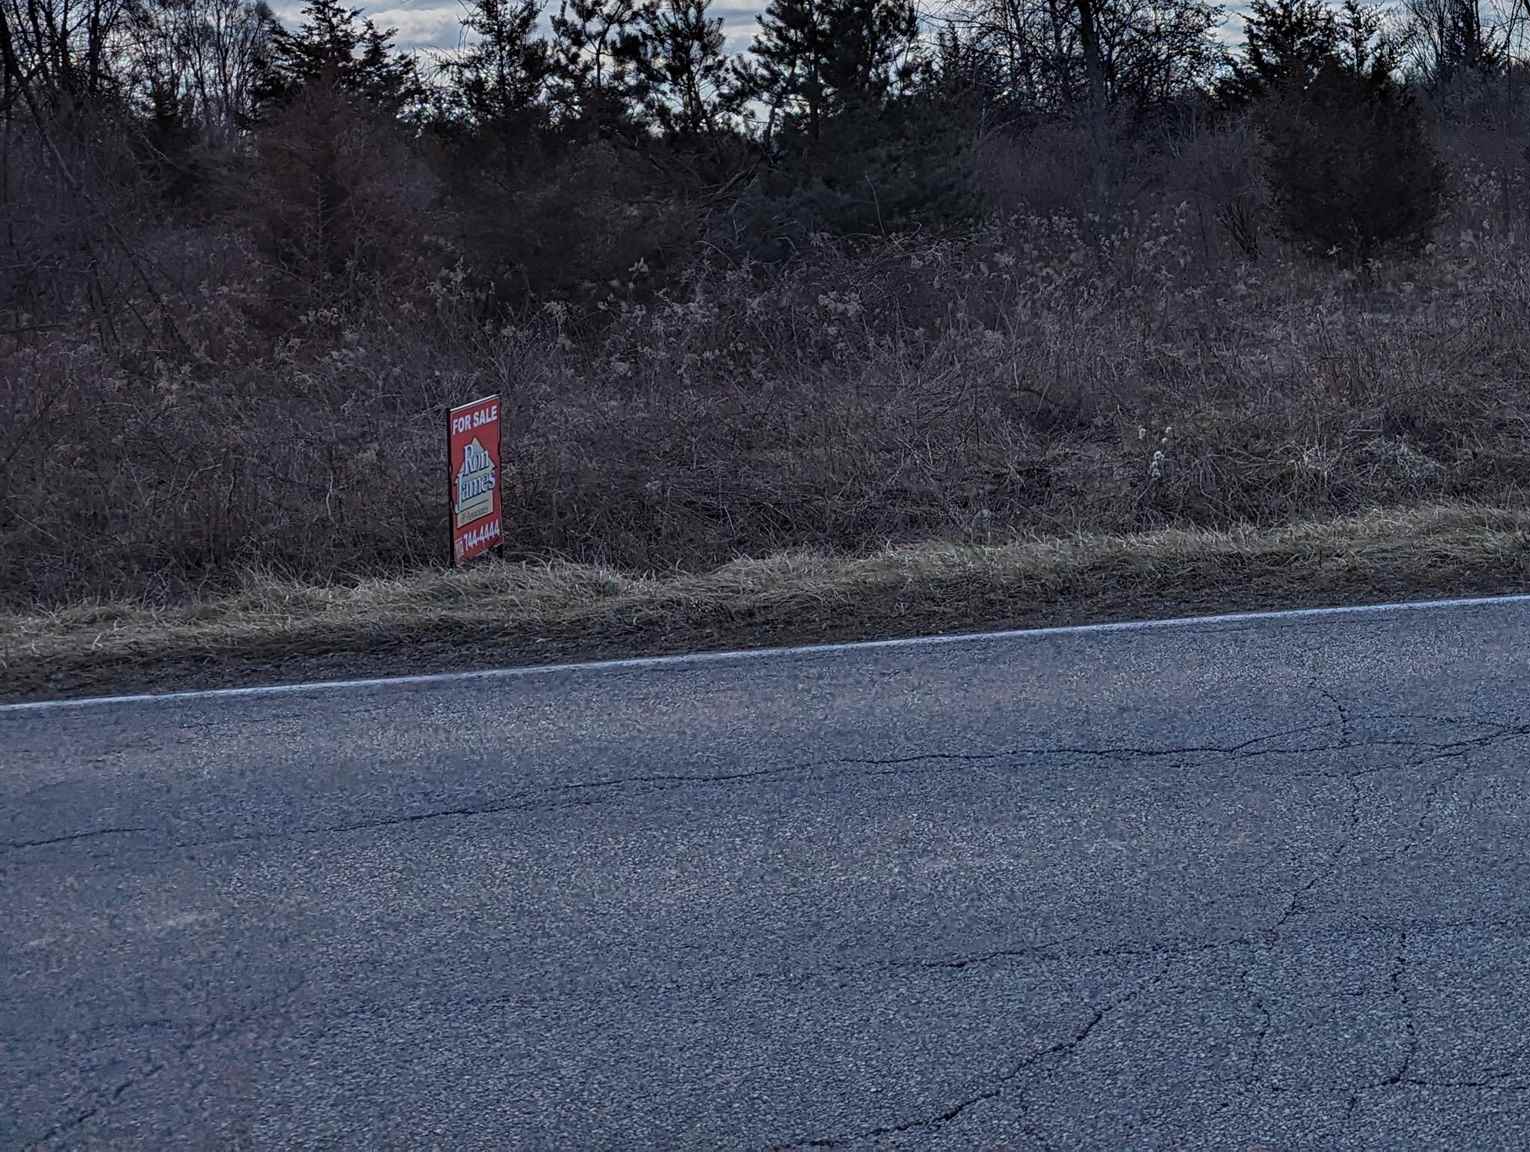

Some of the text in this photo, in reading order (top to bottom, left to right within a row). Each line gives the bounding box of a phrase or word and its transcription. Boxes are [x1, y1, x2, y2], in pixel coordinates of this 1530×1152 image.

[452, 405, 497, 435] FOR SALE
[464, 444, 489, 476] Ron
[455, 471, 496, 513] James
